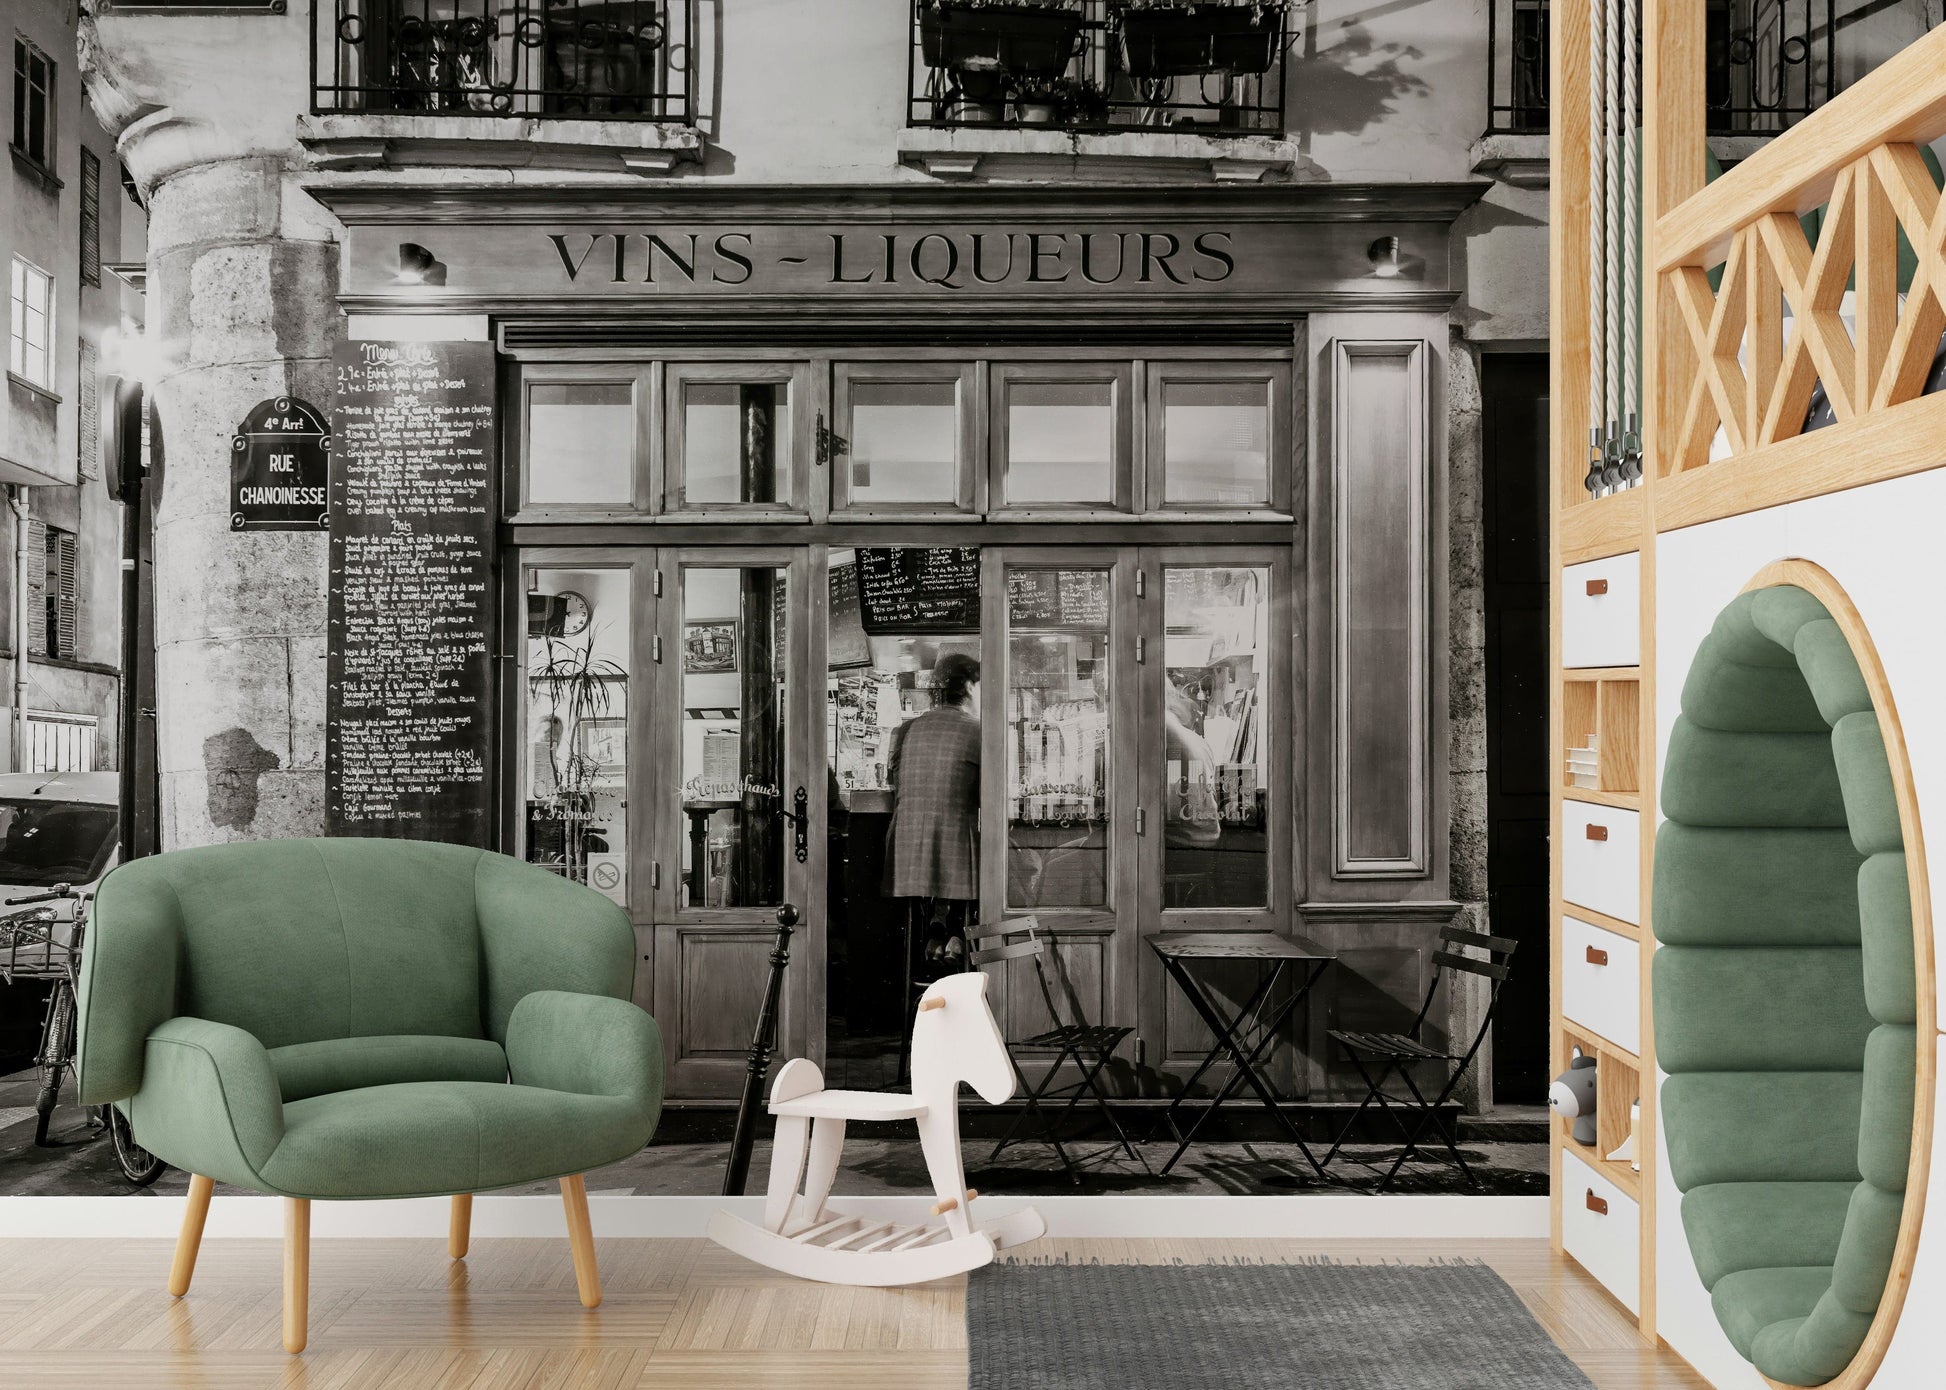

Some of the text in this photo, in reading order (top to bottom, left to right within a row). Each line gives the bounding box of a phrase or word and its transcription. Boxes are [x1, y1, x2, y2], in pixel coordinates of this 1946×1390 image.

[546, 232, 753, 284] VINS
[826, 231, 1235, 289] LIQUEURS
[269, 454, 295, 472] RUE
[239, 487, 326, 504] CHANOINESSE
[391, 520, 412, 532] Plats
